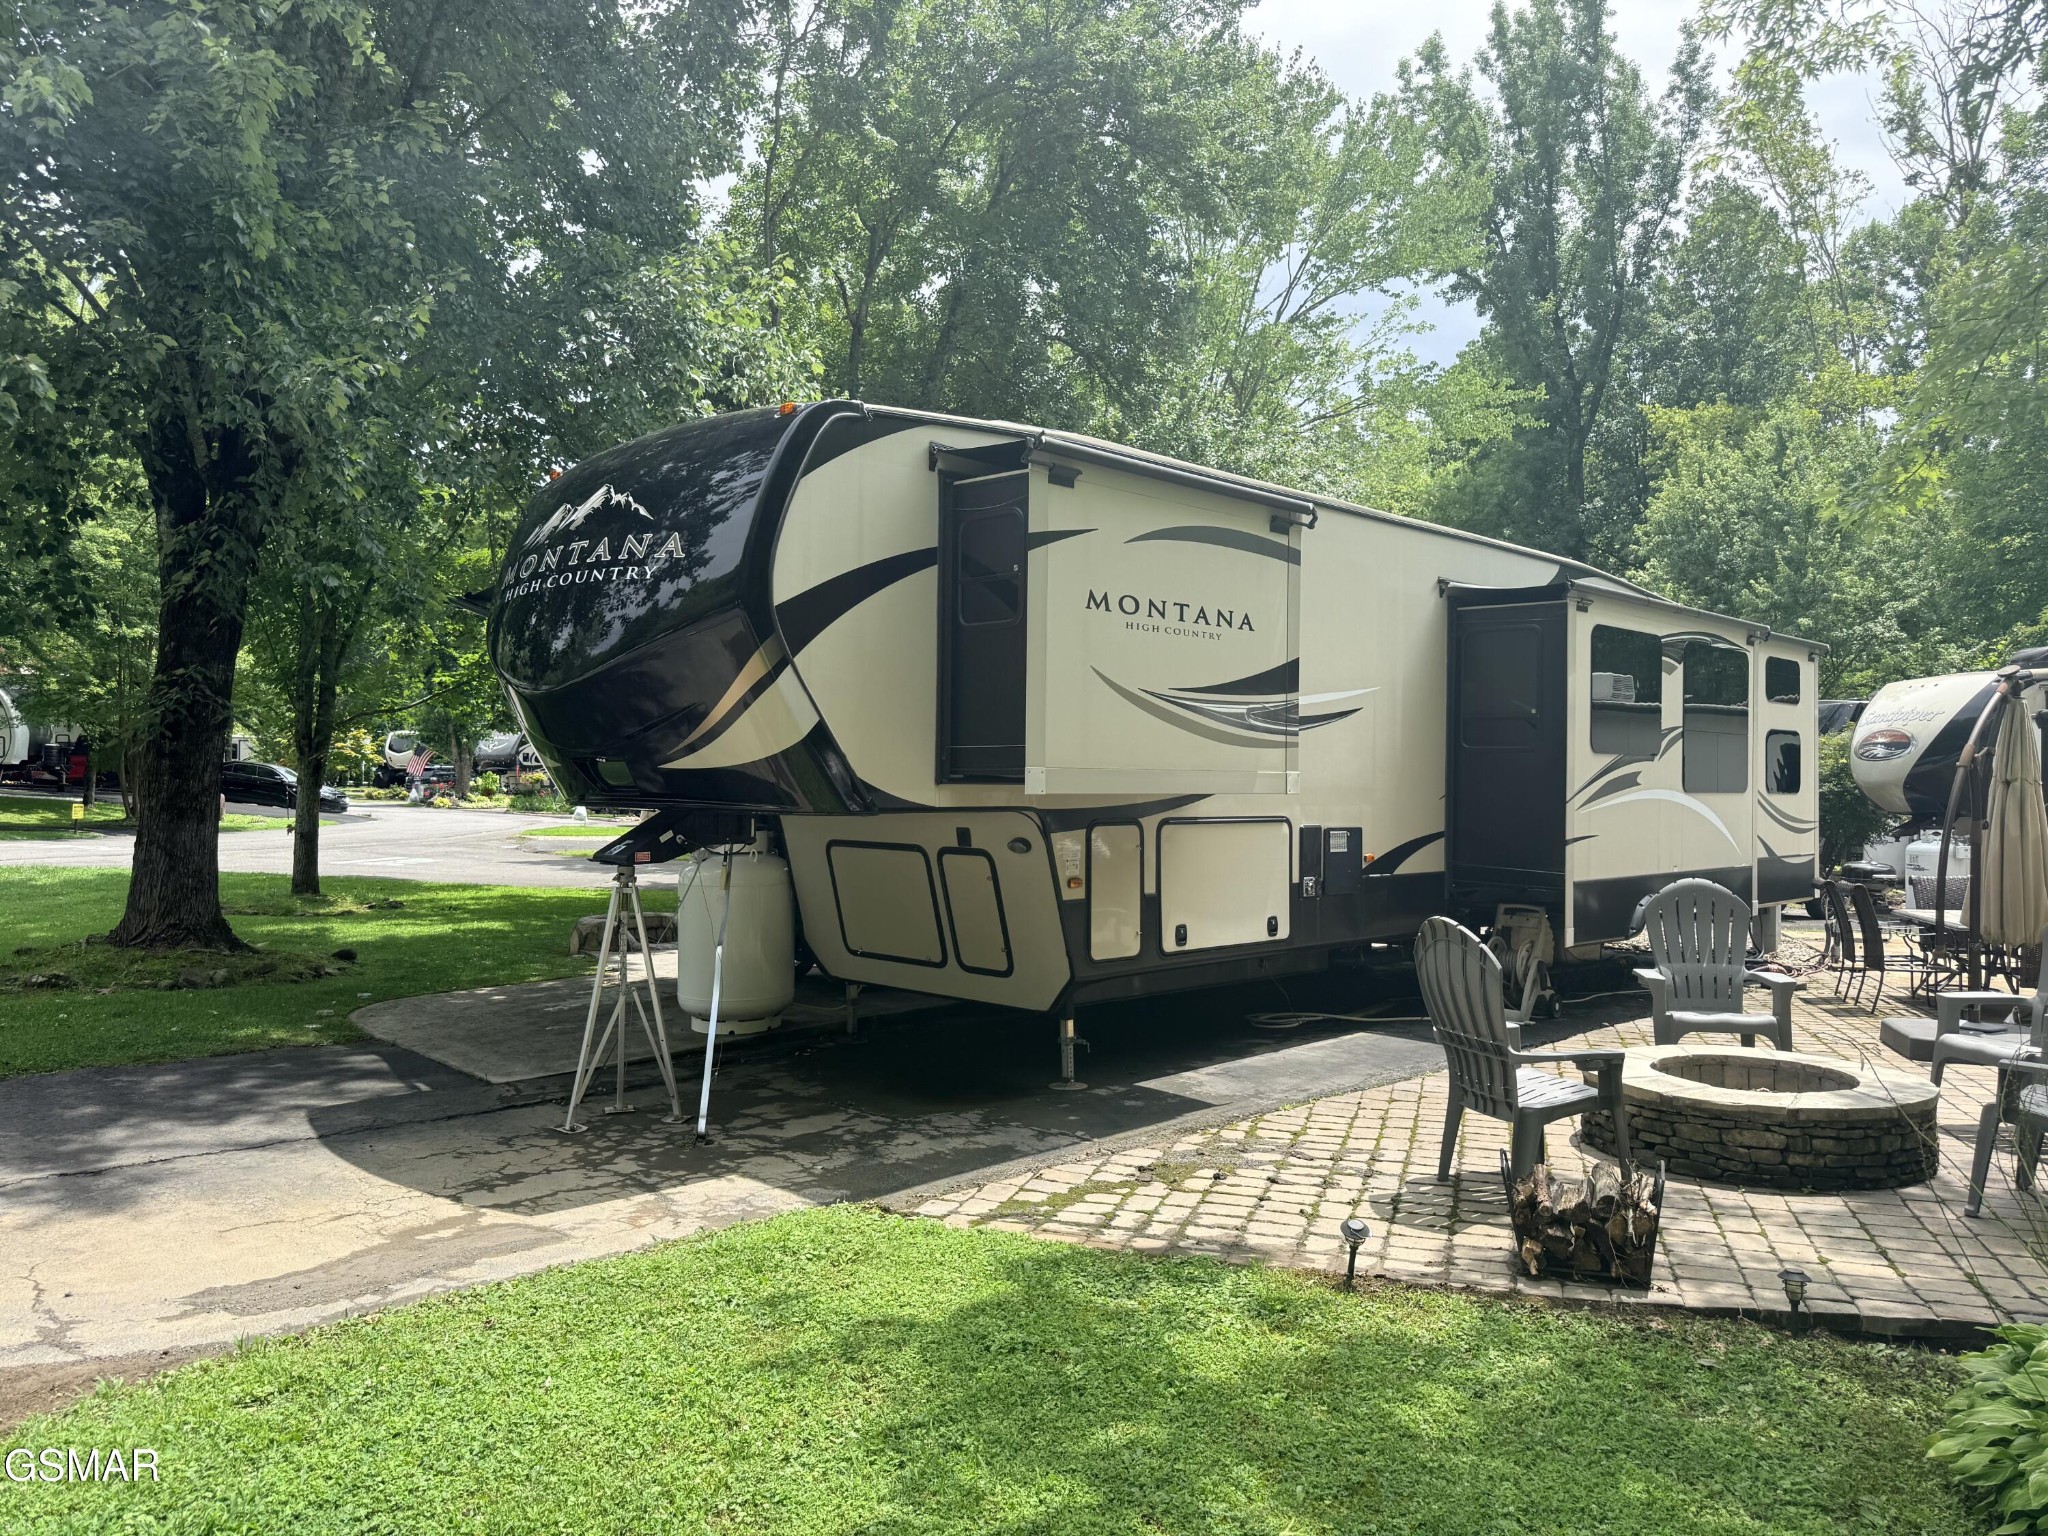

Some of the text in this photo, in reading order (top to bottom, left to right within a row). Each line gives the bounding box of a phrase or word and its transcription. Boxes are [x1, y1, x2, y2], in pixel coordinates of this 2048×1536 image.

[501, 531, 686, 590] MONTANA
[504, 565, 658, 603] HIGH COUNTRY
[1085, 588, 1255, 632] MONTANA
[1125, 621, 1222, 641] HIGH COUNTRY
